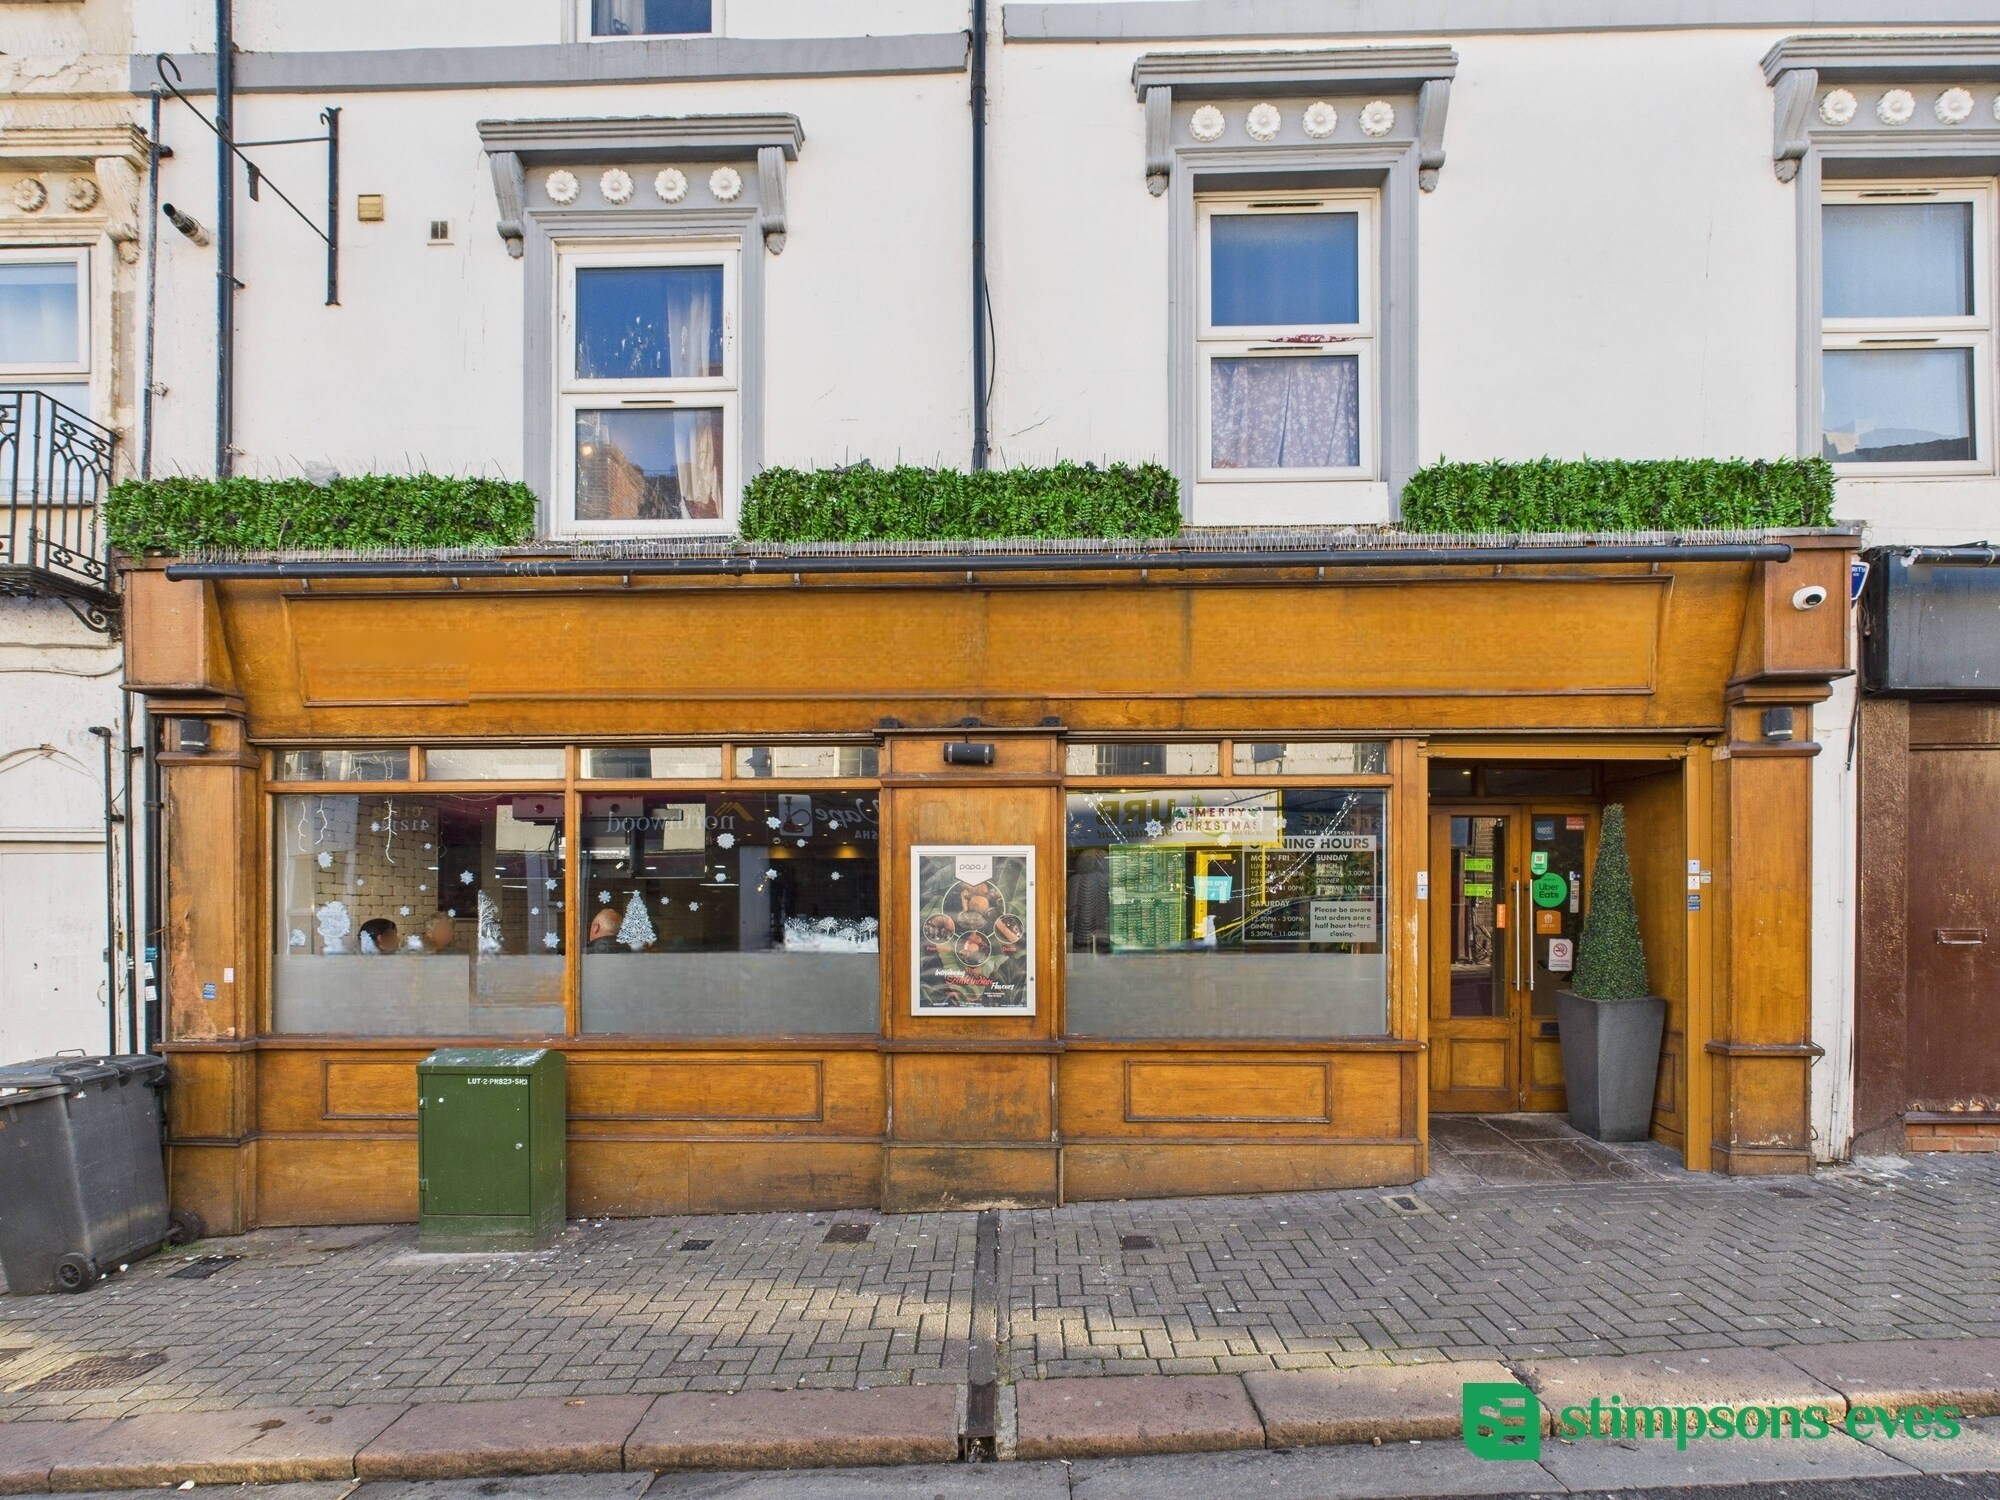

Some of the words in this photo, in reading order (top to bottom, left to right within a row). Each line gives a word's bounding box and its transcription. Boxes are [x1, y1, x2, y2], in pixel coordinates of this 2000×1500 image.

[1195, 807, 1246, 818] MERRY
[1175, 820, 1257, 832] CHRISTMAS
[1320, 838, 1370, 849] HOURS
[1250, 854, 1271, 862] MON
[1538, 882, 1559, 891] Uber
[1538, 890, 1559, 900] Eats
[1314, 906, 1338, 914] Please
[1330, 930, 1356, 938] closing.
